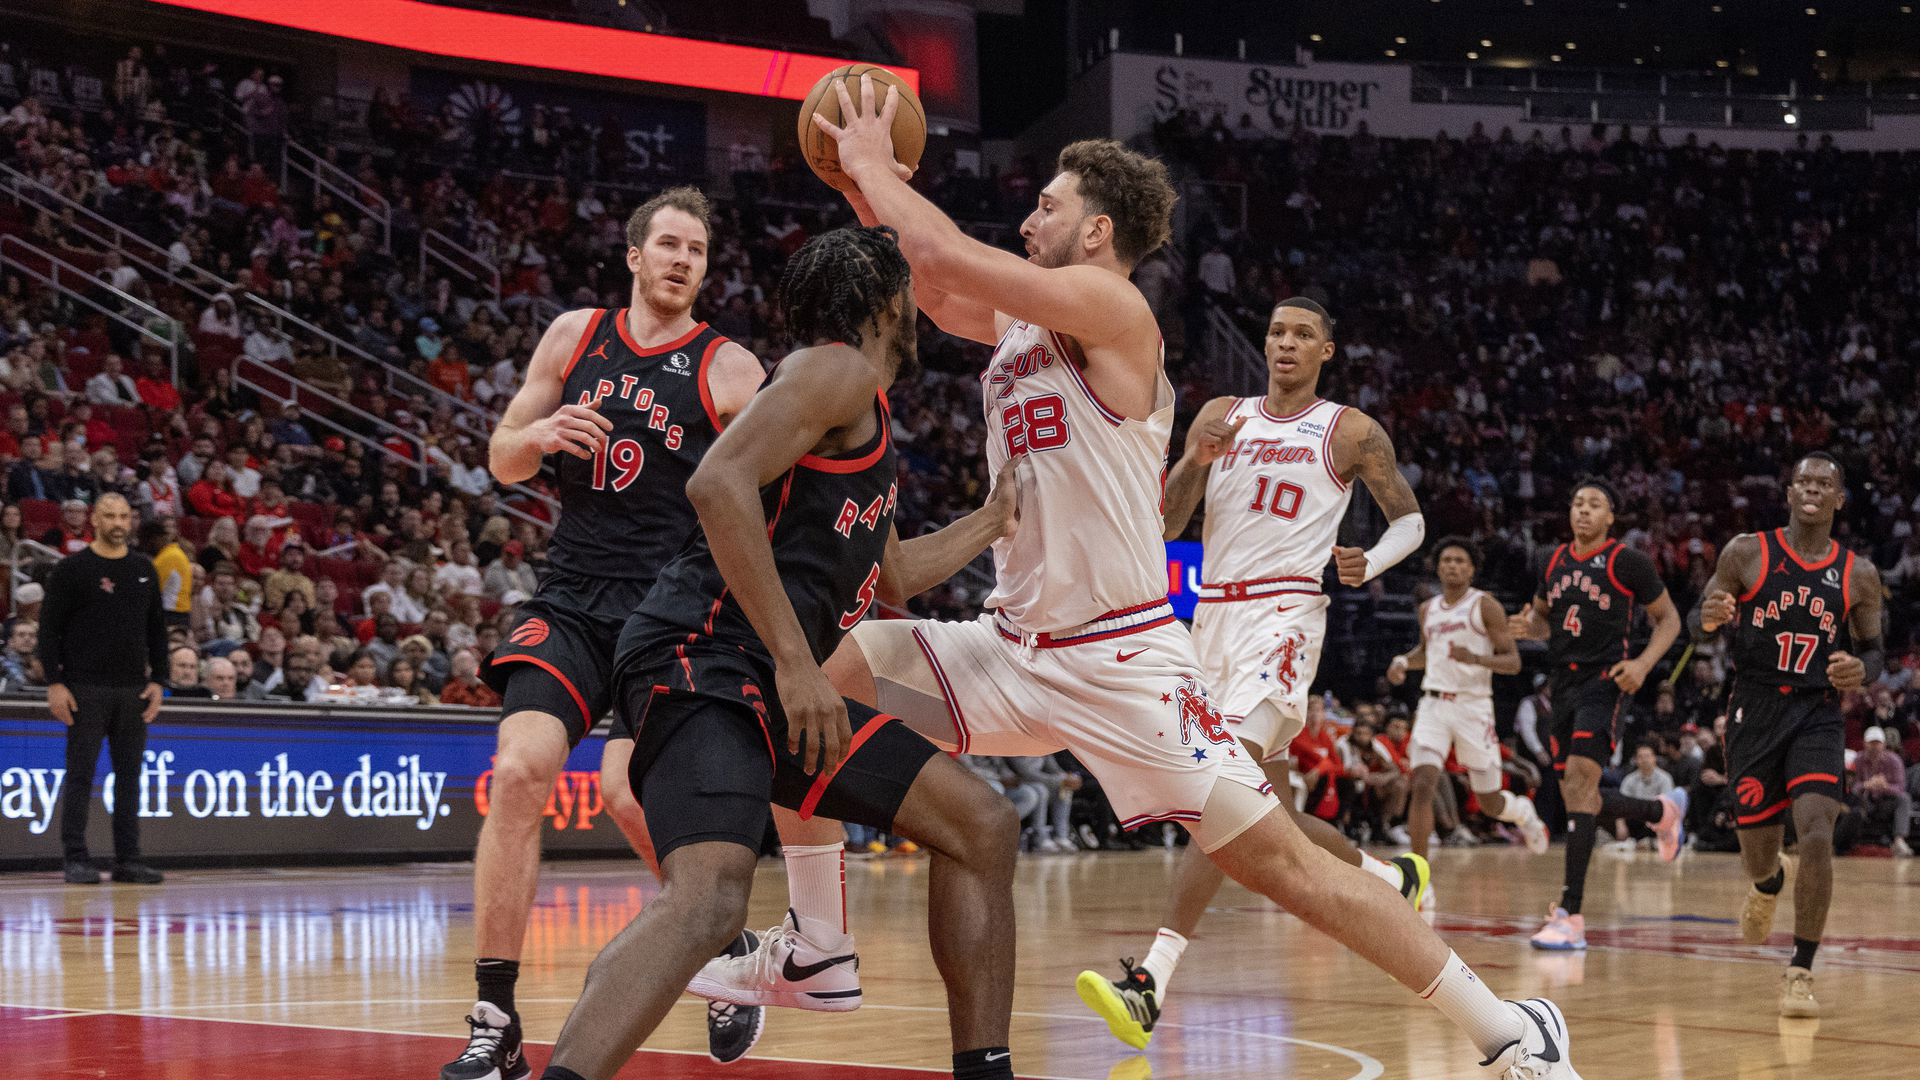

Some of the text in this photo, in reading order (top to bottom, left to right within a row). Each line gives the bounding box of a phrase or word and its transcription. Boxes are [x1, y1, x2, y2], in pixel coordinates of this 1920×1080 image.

[1246, 68, 1380, 109] Supper
[1268, 96, 1349, 130] Club
[577, 374, 684, 451] APTORS
[1001, 392, 1072, 460] 28
[1296, 426, 1324, 440] karma
[1300, 420, 1326, 433] credit
[591, 435, 645, 493] 19
[1221, 437, 1318, 473] H-Town
[1248, 474, 1307, 523] 10
[838, 561, 880, 630] 5
[1562, 604, 1582, 637] 4
[1775, 631, 1819, 674] 17
[0, 766, 67, 834] ay
[184, 768, 251, 818] on
[255, 752, 334, 818] the
[342, 753, 451, 831] daily.
